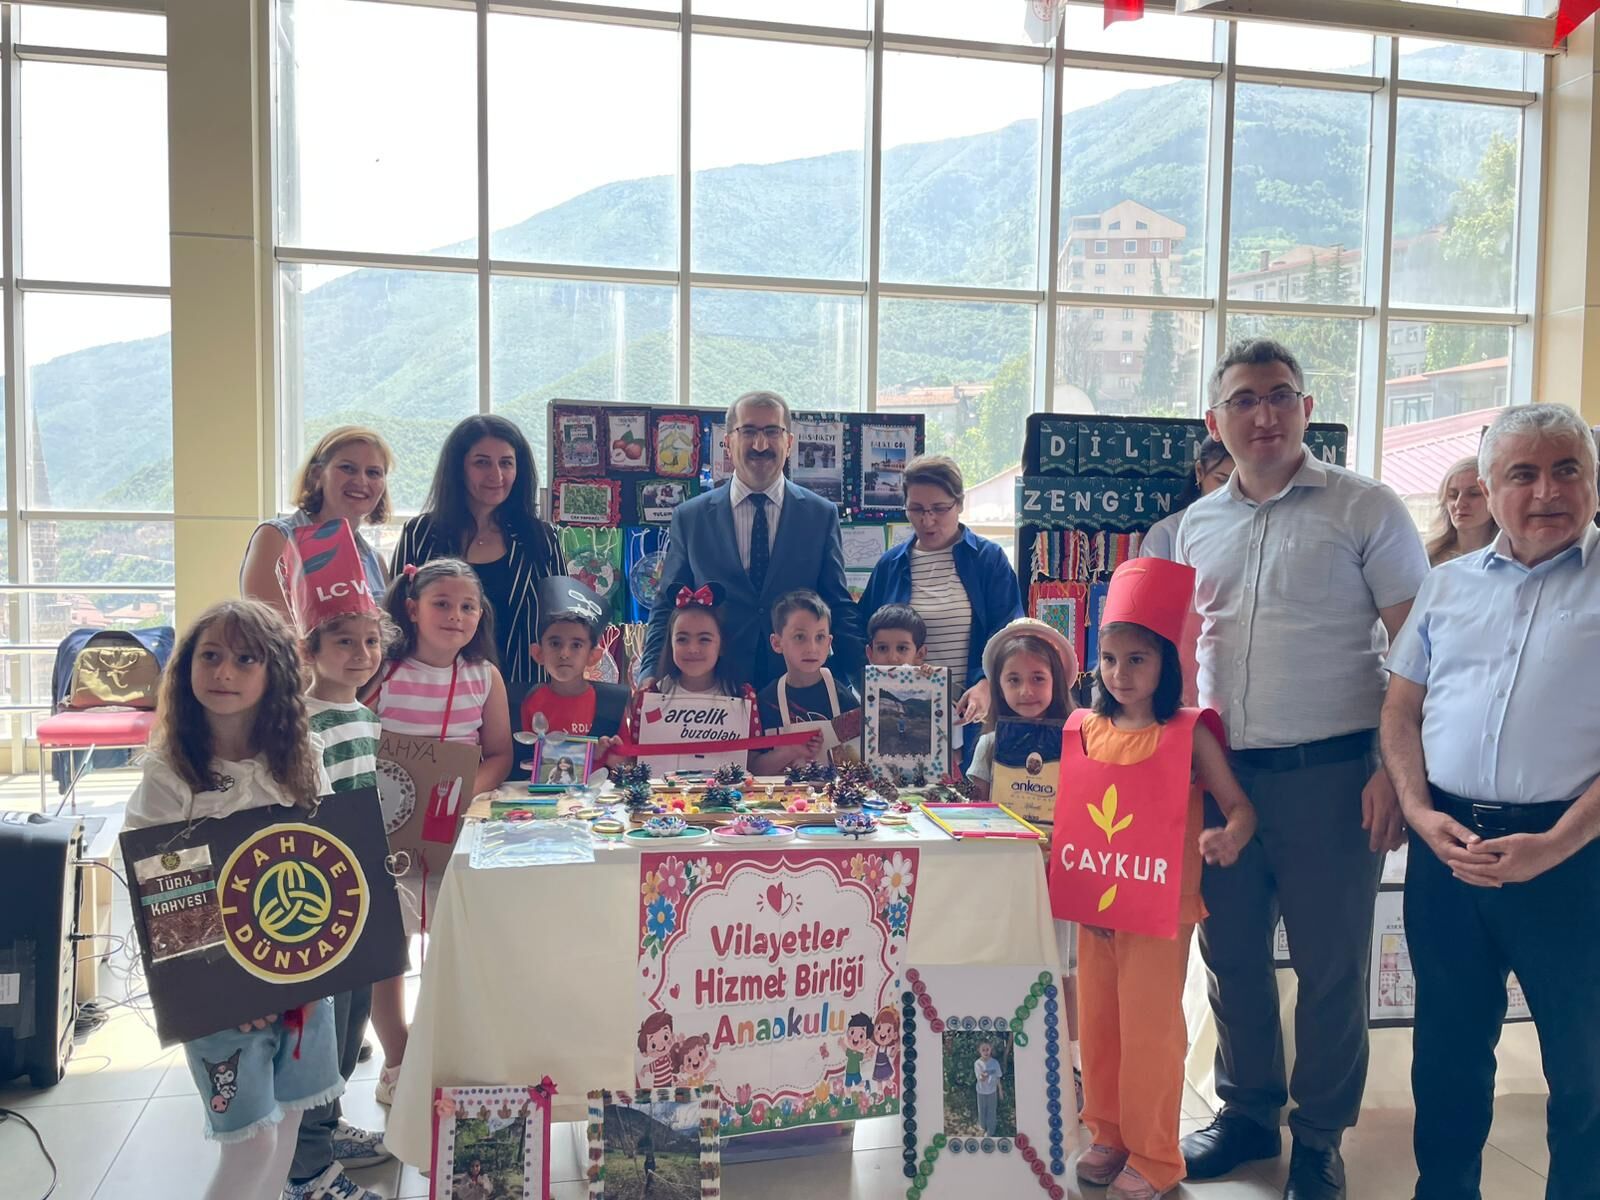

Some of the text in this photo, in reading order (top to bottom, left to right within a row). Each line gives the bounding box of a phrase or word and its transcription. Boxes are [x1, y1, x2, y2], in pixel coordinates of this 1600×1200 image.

[664, 706, 728, 727] arçelik
[1010, 780, 1053, 793] ankara
[156, 874, 193, 892] TÜRK
[231, 836, 347, 894] KAHVE
[1061, 843, 1167, 884] ÇAYKUR
[234, 909, 353, 969] DÜNYASI
[710, 921, 849, 964] Vilayetler
[695, 955, 864, 1005] Hizmet Birliği
[712, 1002, 846, 1050] Anaokulu
